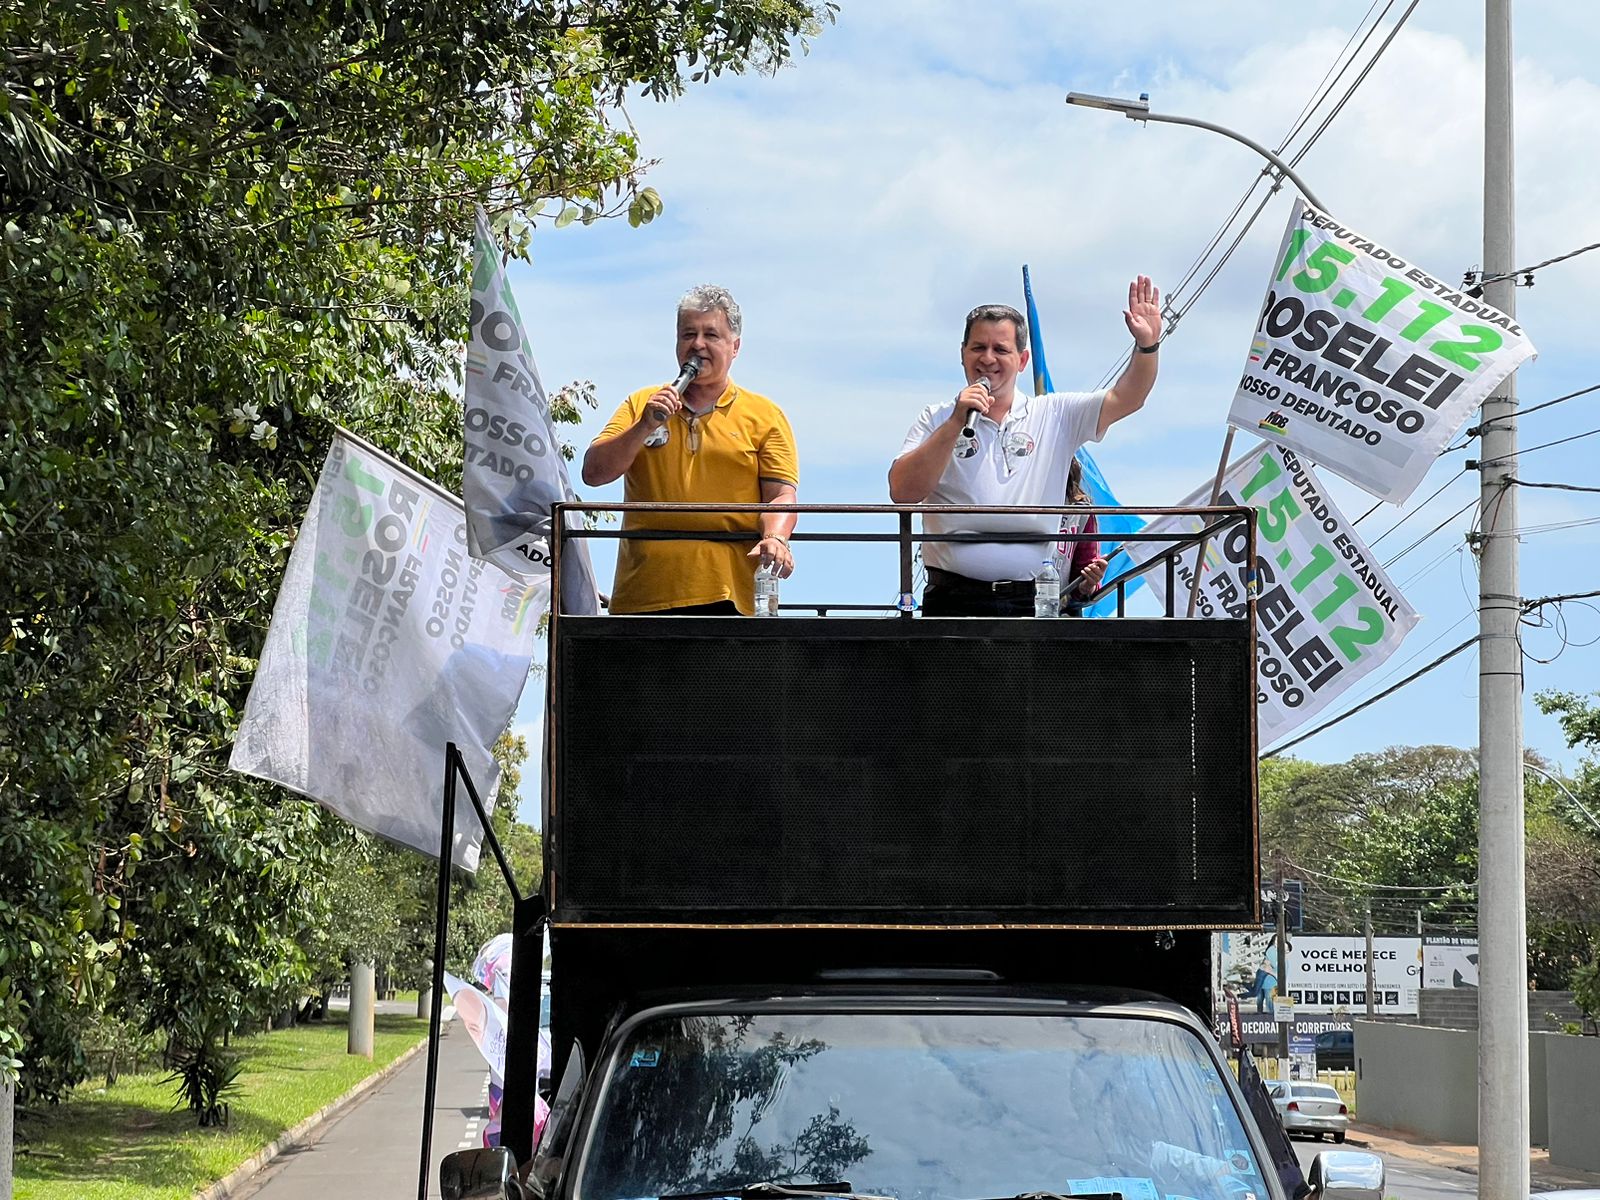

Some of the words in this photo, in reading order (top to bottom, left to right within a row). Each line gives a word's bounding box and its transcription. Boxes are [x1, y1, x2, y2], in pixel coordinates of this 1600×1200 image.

[1276, 228, 1504, 373] 15.112
[1301, 208, 1406, 271] DEPUTADO
[1403, 269, 1522, 337] ESTADUAL
[1262, 349, 1425, 434] FRANÇOSO
[1280, 392, 1382, 447] DEPUTADO
[1240, 452, 1386, 663] 15.112
[1332, 531, 1400, 622] ESTADUAL
[1301, 947, 1338, 960] VOCÊ
[1301, 963, 1310, 972] O
